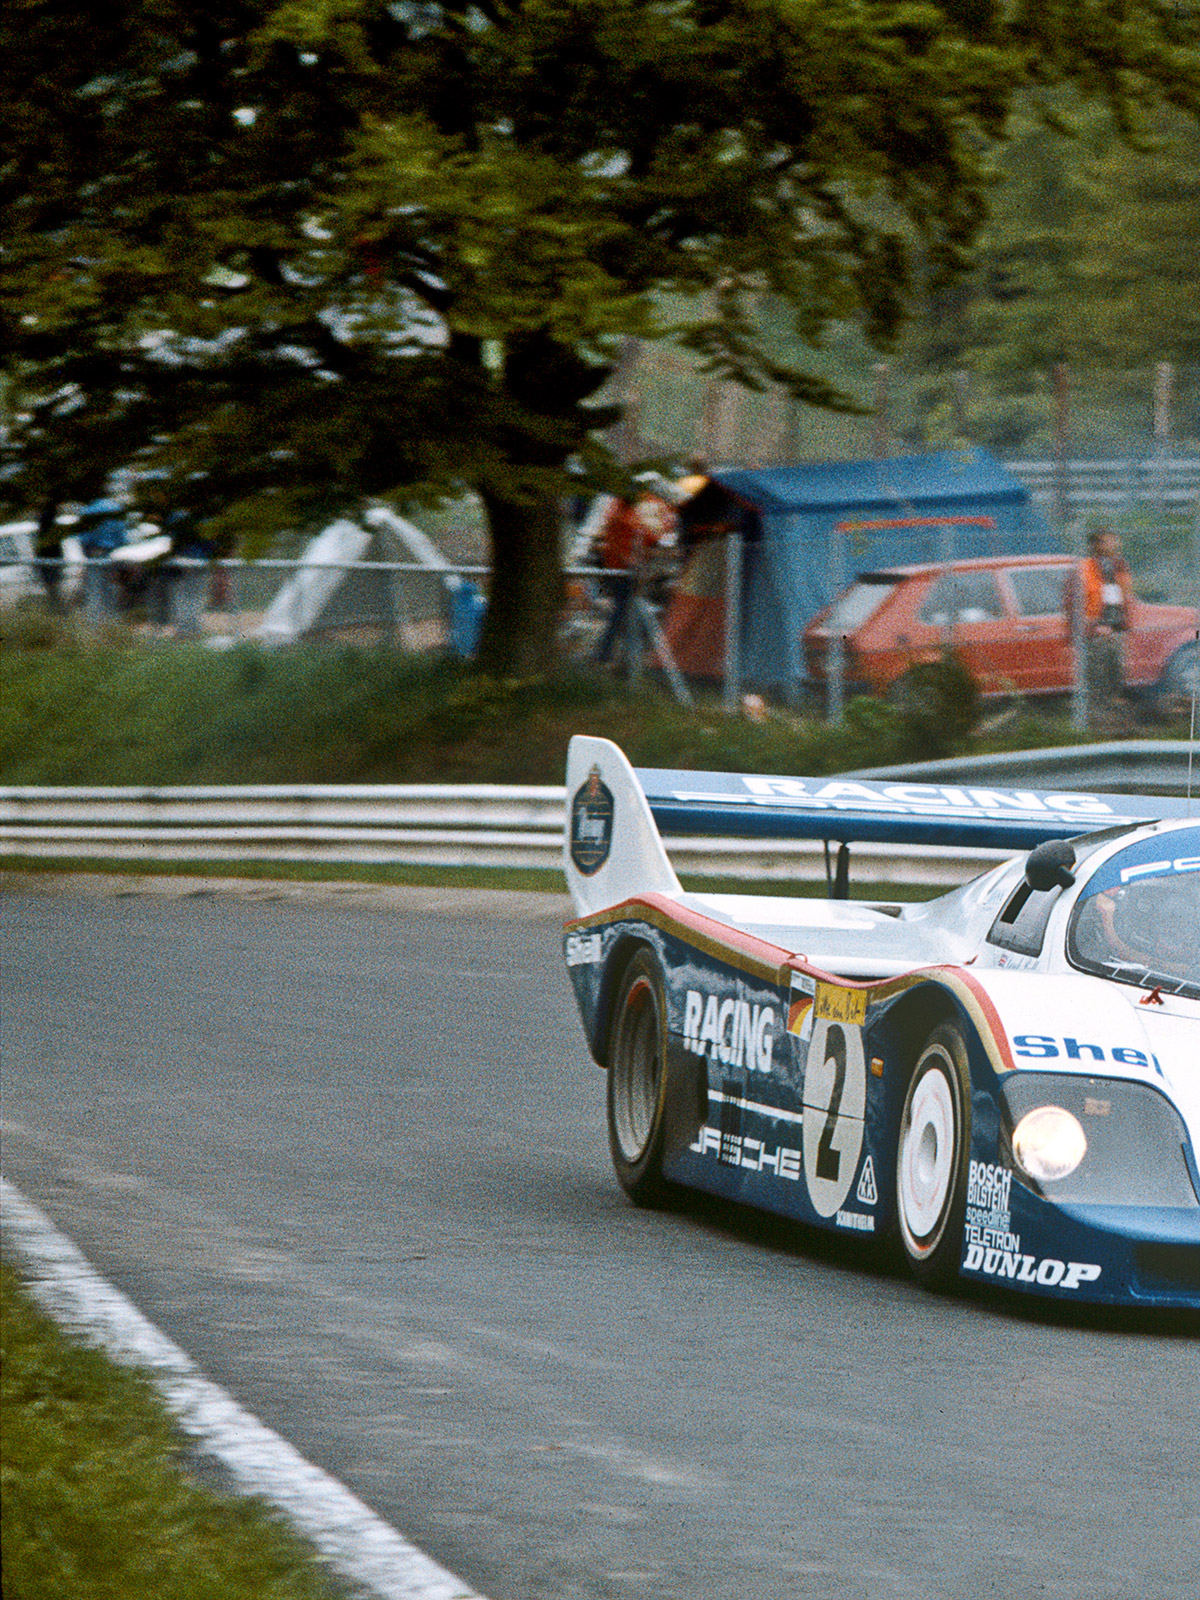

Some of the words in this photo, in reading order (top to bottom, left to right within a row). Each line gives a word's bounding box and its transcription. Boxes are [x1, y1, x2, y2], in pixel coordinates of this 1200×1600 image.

[741, 777, 1114, 813] RACING
[683, 990, 774, 1073] RACING
[816, 1024, 848, 1182] 2
[969, 1160, 1013, 1195] BOSCH
[967, 1181, 1010, 1213] BILSTEIN
[964, 1223, 1020, 1253] TELETRON
[963, 1243, 1102, 1290] DUNLOP
